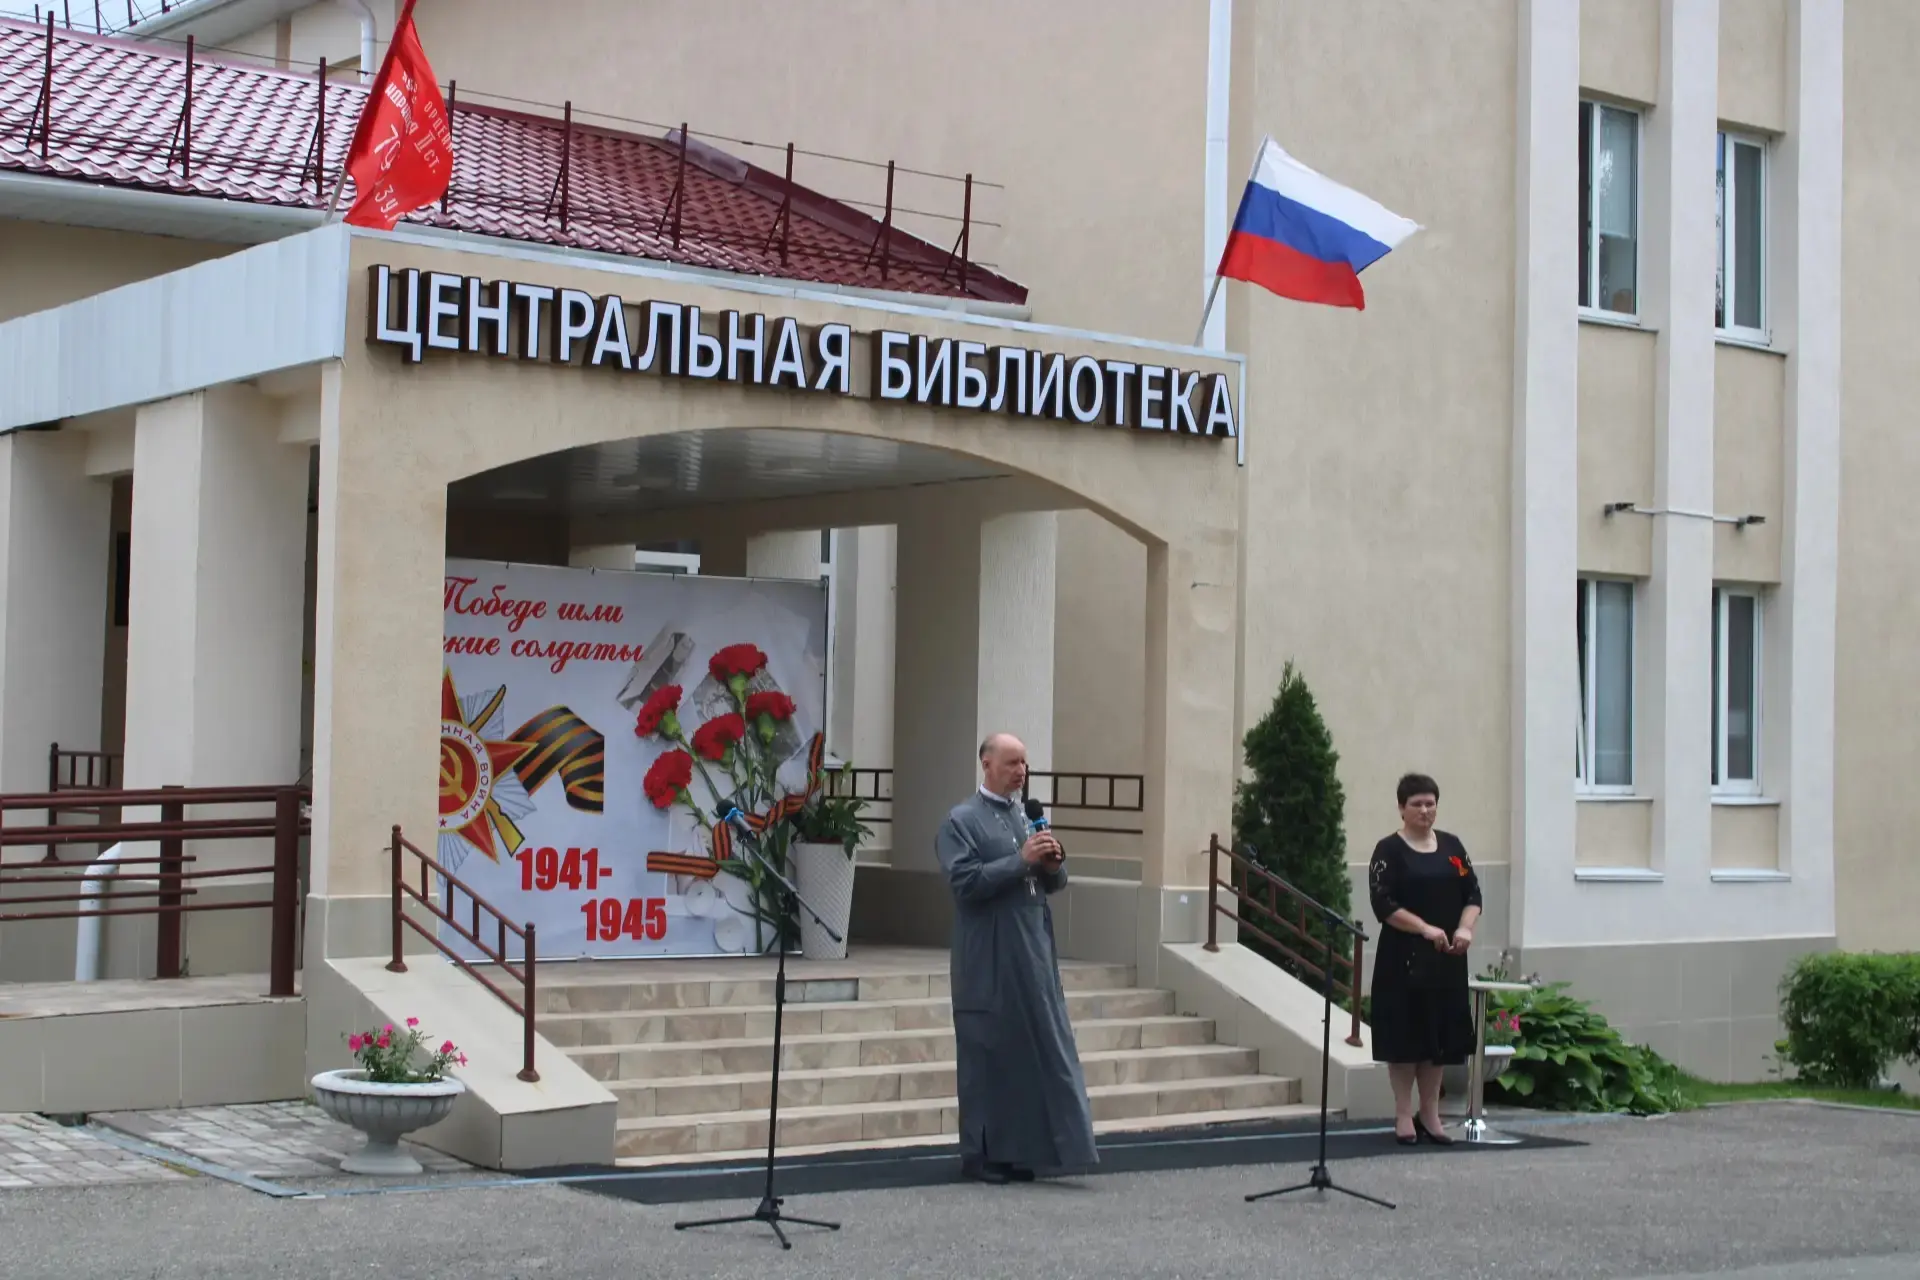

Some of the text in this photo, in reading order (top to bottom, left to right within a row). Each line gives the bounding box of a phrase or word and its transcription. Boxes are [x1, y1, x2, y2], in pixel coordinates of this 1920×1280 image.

[370, 264, 1237, 437] ЦЕНТРАЛЬНАЯ БИБЛИОТЕКА
[444, 576, 624, 633] Победе шли
[511, 639, 645, 675] солдаты
[515, 847, 612, 891] 1941-
[580, 898, 667, 942] 1945
